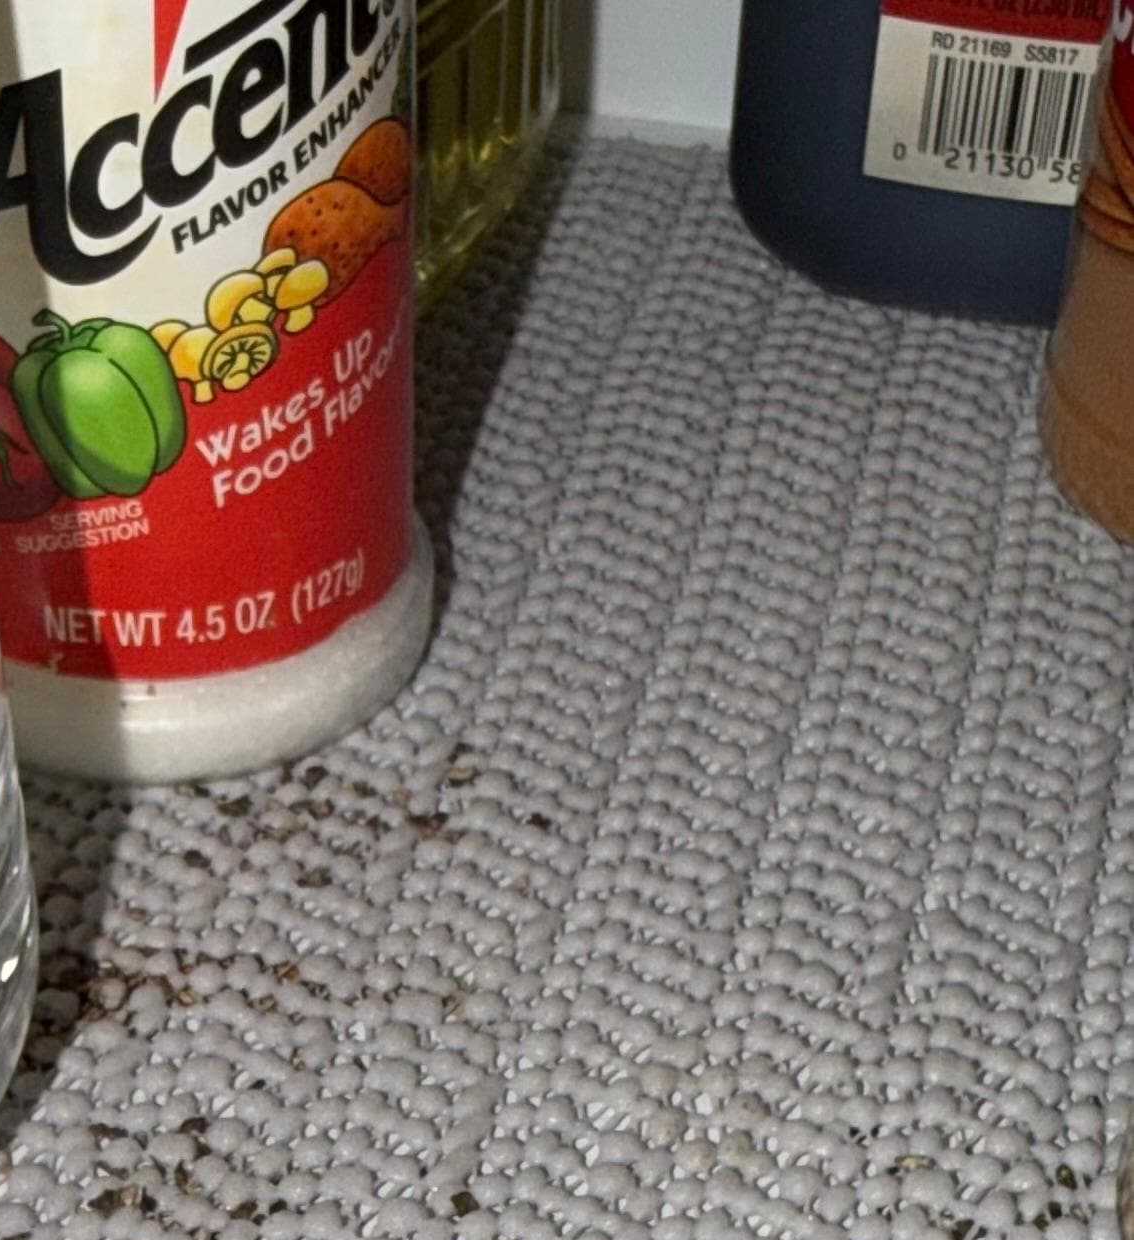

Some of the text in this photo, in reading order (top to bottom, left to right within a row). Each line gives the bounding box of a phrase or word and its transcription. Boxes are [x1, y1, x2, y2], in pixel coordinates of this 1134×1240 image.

[171, 17, 401, 254] FLAVOR ENHANCER
[944, 149, 1034, 181] 21130
[195, 378, 325, 468] Wakes
[212, 426, 315, 509] Food
[15, 518, 150, 553] SUGGESTION
[50, 501, 143, 531] SERVING
[43, 549, 364, 647] NET WT 4.5 OZ (127g)
